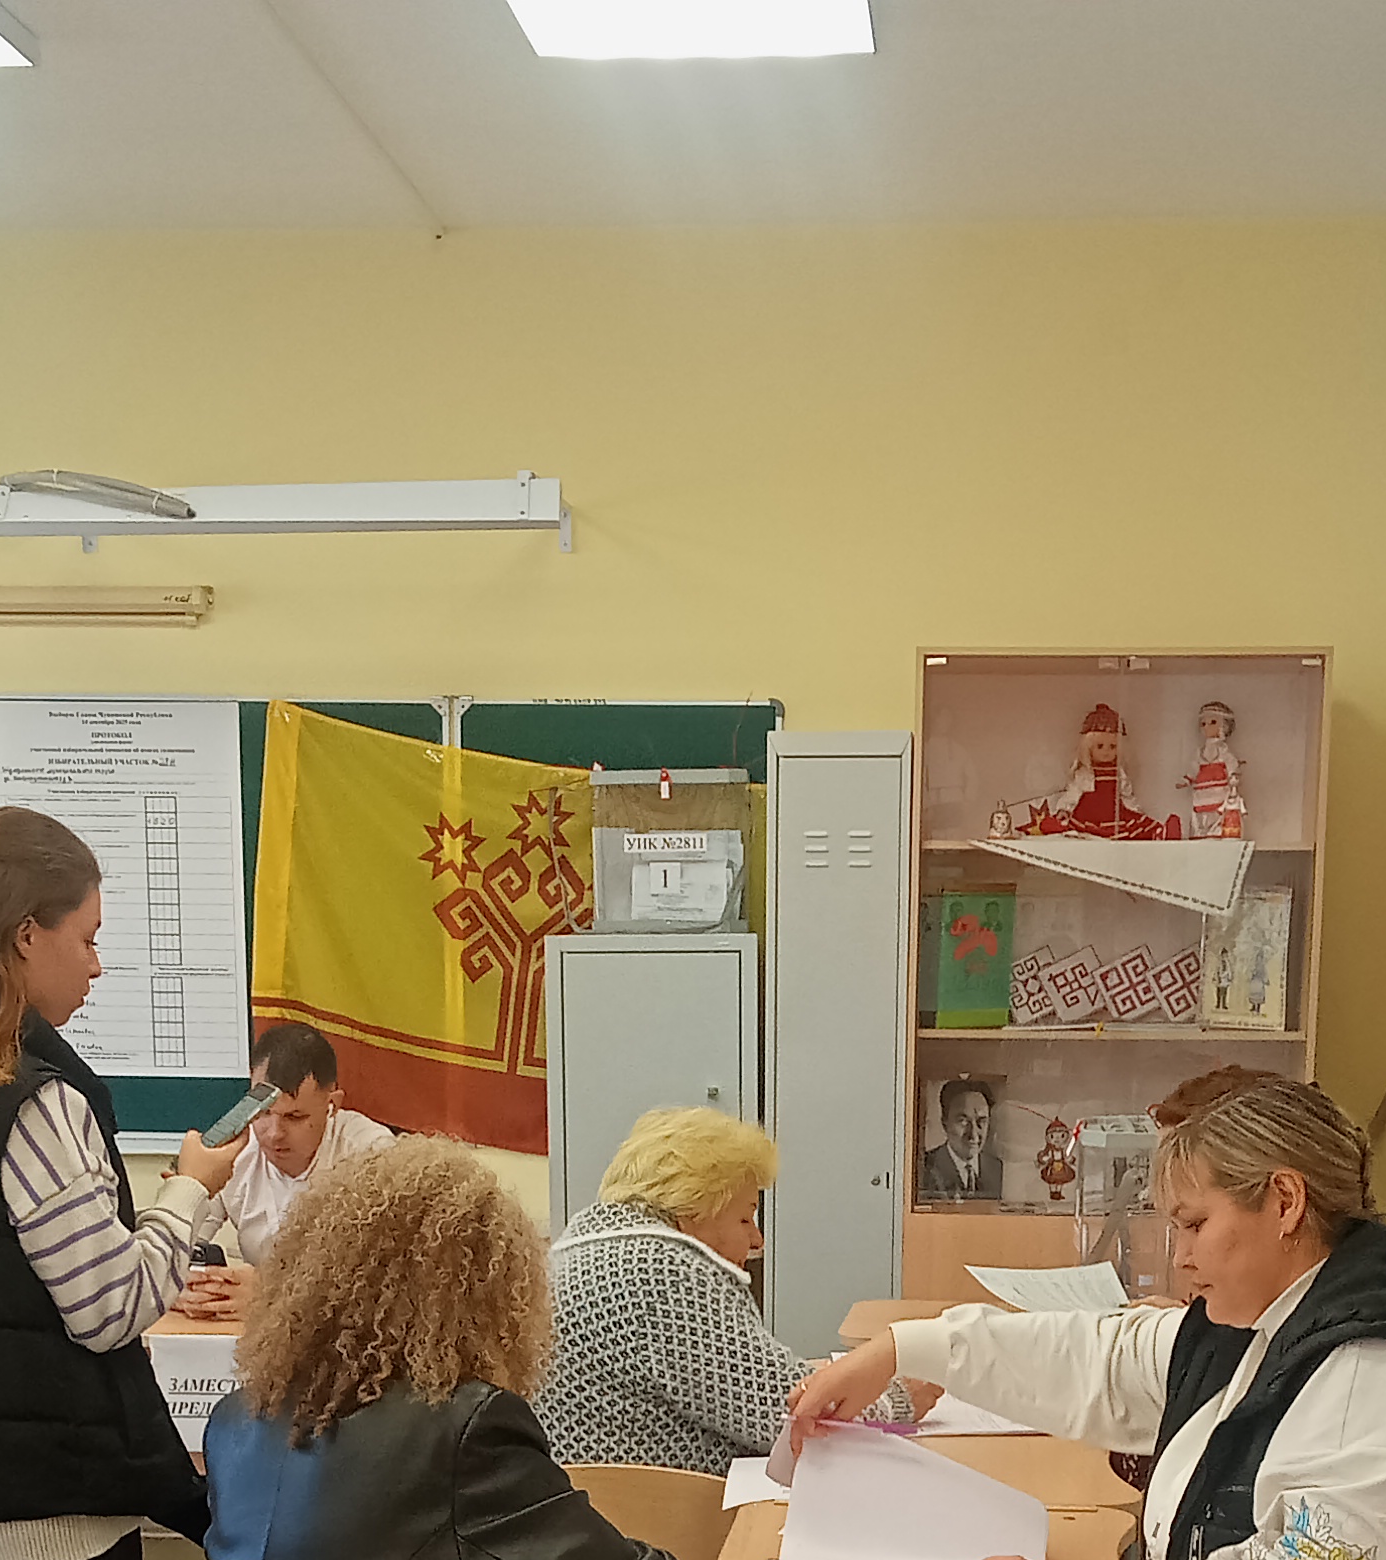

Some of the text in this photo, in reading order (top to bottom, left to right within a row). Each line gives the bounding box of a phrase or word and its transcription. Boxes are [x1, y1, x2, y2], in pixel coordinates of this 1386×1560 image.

[626, 837, 704, 850] УИК №2811
[662, 868, 668, 888] 1
